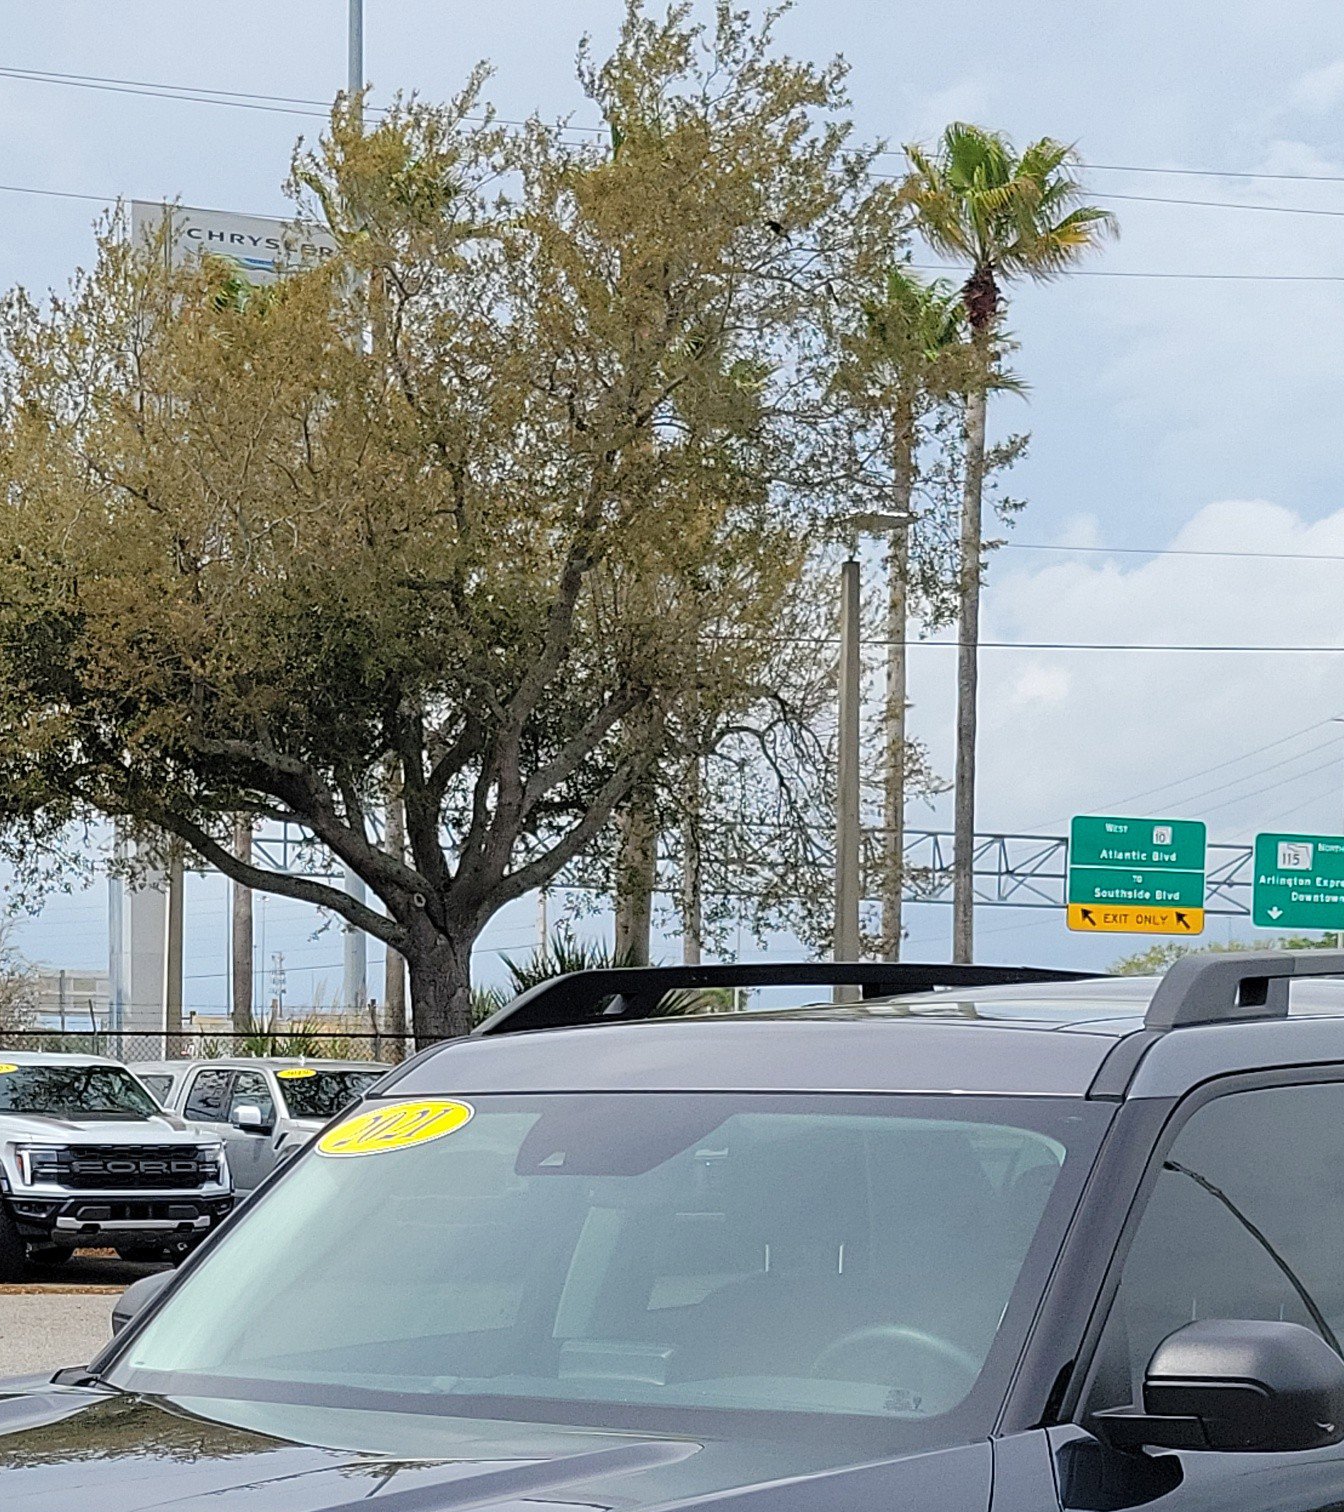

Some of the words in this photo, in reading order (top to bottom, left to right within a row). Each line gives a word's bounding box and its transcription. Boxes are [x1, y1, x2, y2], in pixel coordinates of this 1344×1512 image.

[186, 228, 333, 257] CHRYSLER
[1099, 849, 1147, 861] Atlantic
[1152, 851, 1177, 862] Blvd
[1282, 853, 1300, 866] 115
[1259, 874, 1312, 888] Arlington
[1094, 887, 1151, 900] Southside
[1155, 890, 1180, 901] Blvd
[1103, 913, 1129, 924] EXIT
[1135, 913, 1168, 926] ONLY
[332, 1107, 456, 1147] 2021
[71, 1161, 197, 1175] FORD
